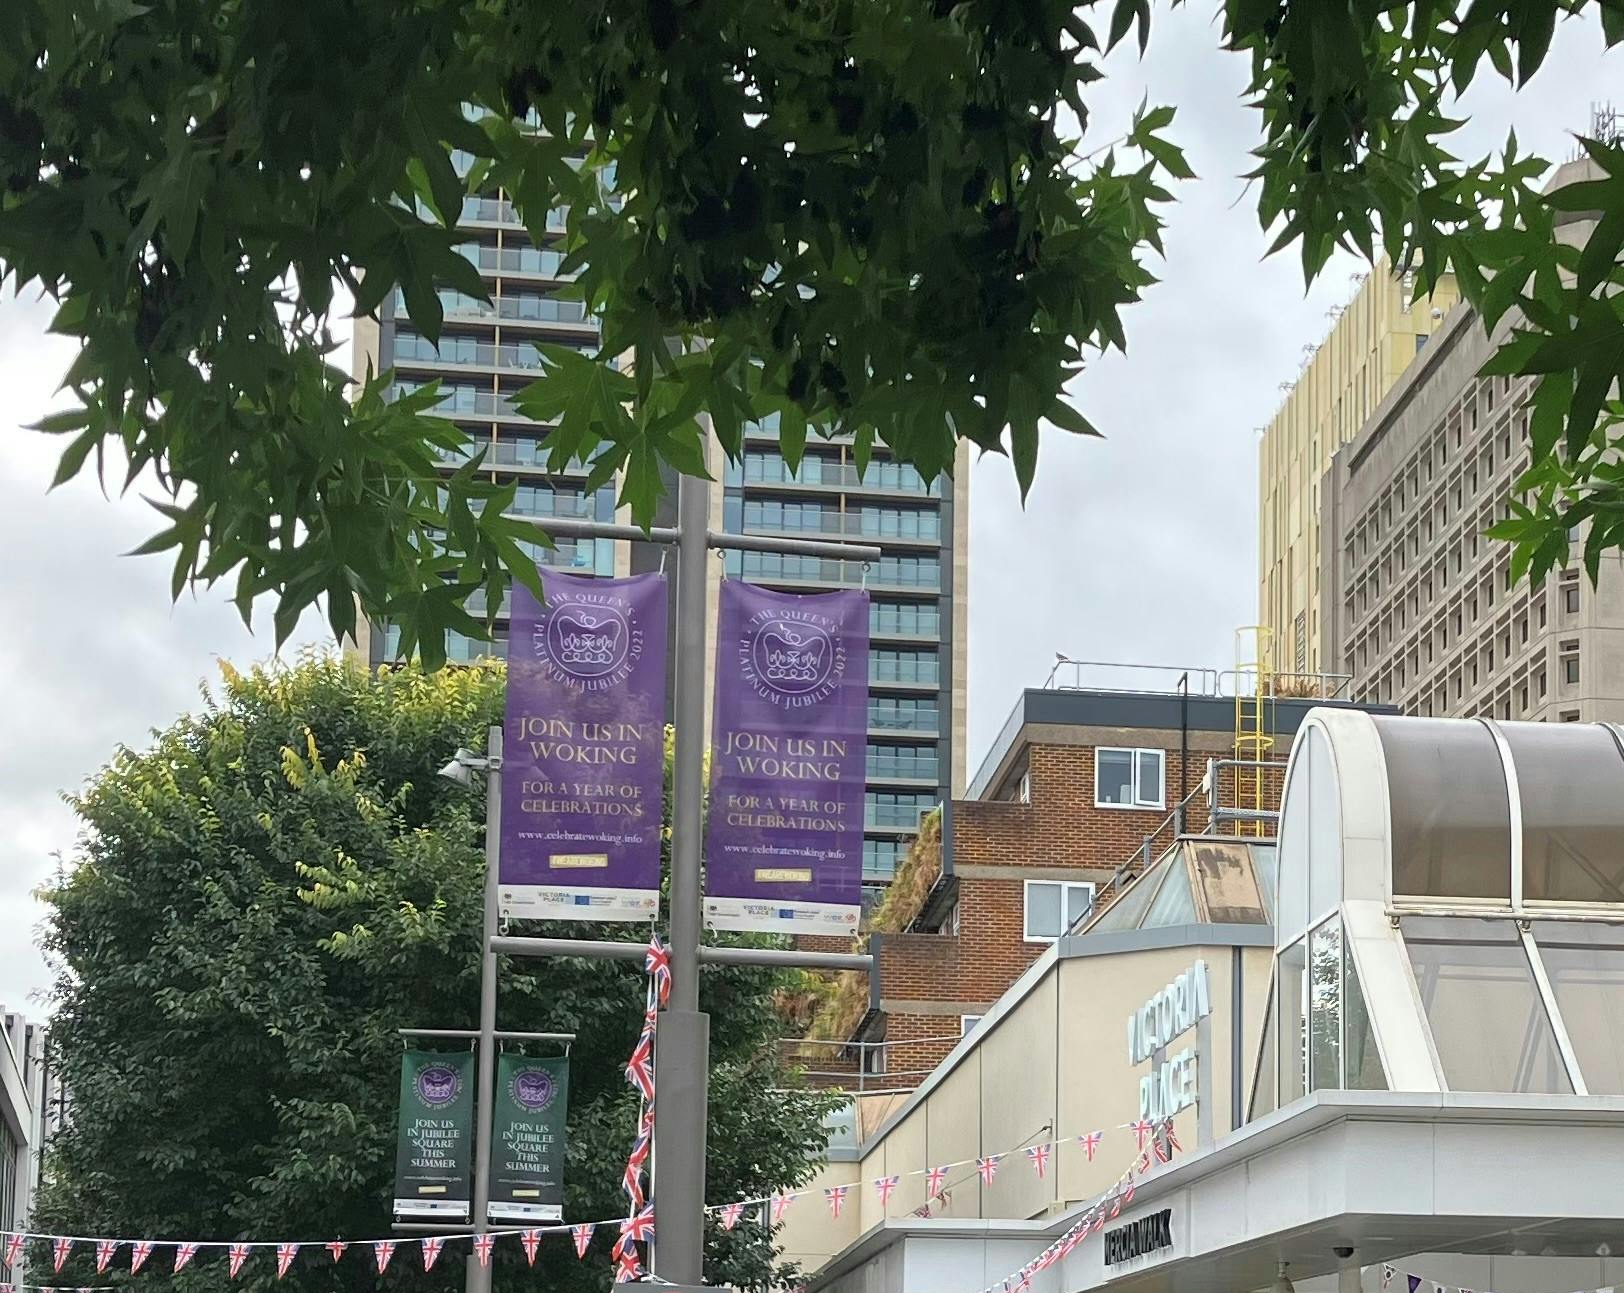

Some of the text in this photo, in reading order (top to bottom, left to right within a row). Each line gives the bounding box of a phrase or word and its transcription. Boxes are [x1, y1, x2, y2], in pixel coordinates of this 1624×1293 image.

[545, 593, 568, 608] THE
[532, 624, 644, 694] PLATINUM JUBILEE 2022
[739, 639, 781, 705] PLATINUM
[785, 679, 838, 710] JUBILEE
[518, 717, 644, 742] JOIN US IN
[530, 741, 639, 766] WOKING
[725, 732, 847, 758] JOIN US IN
[737, 756, 842, 781] WOKING
[522, 781, 643, 799] FOR A YEAR OF
[521, 799, 643, 818] CELEBRATIONS
[728, 796, 846, 815] FOR A YEAR OF
[727, 814, 846, 833] CELEBRATIONS
[518, 830, 643, 846] www.celebratewoking.info
[724, 844, 846, 861] www.celebratewoking.info
[1127, 959, 1210, 1066] VICTORIA
[1139, 1049, 1196, 1121] PLACE
[415, 1119, 454, 1129] JOIN US
[510, 1122, 549, 1133] JOIN US
[407, 1128, 460, 1140] IN JUBILEE
[502, 1131, 554, 1144] IN JUBILEE
[412, 1139, 454, 1152] SQUARE
[422, 1150, 445, 1158] THIS
[507, 1142, 549, 1155] SQUARE
[410, 1159, 456, 1168] SUMMER
[516, 1153, 539, 1162] THIS
[505, 1162, 550, 1172] SUMMER
